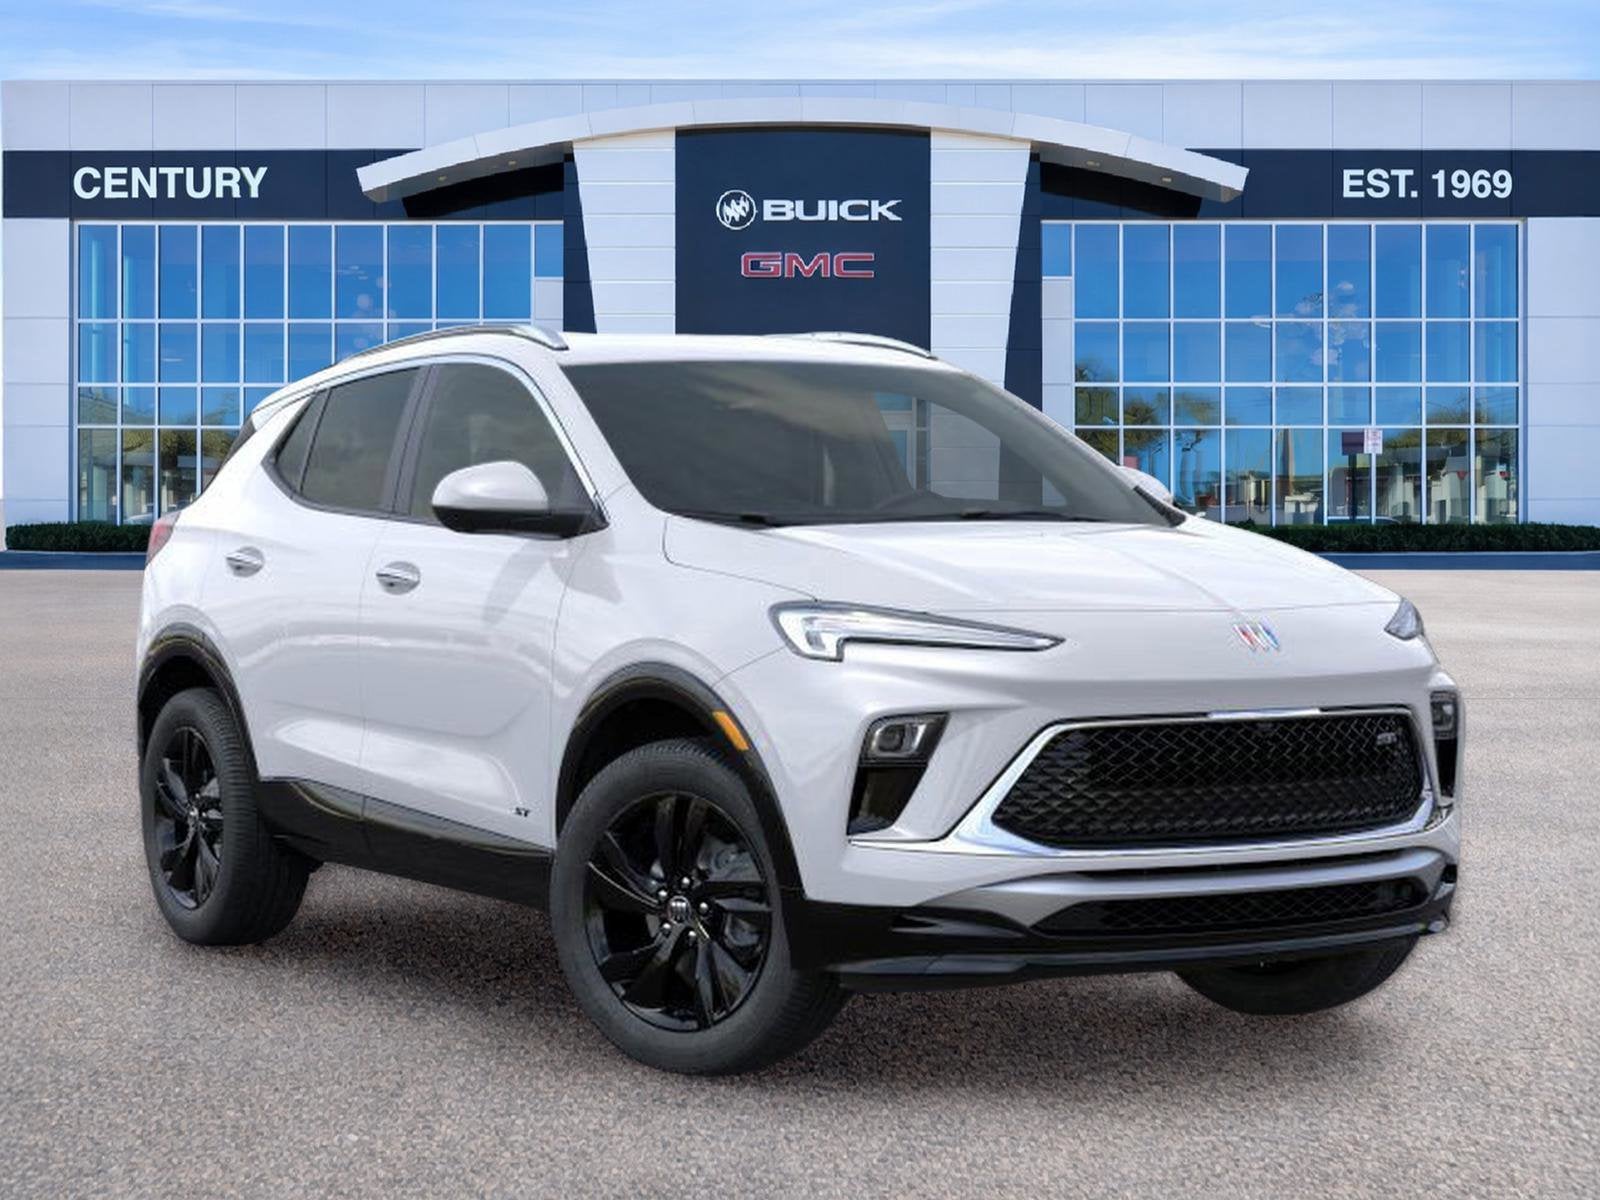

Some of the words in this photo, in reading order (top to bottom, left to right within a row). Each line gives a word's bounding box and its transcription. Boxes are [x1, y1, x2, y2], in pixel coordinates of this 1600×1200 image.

[73, 166, 268, 199] CENTURY
[1342, 168, 1418, 198] EST.
[1431, 169, 1513, 199] 1969
[763, 199, 903, 221] BUICK
[741, 252, 875, 278] GMC
